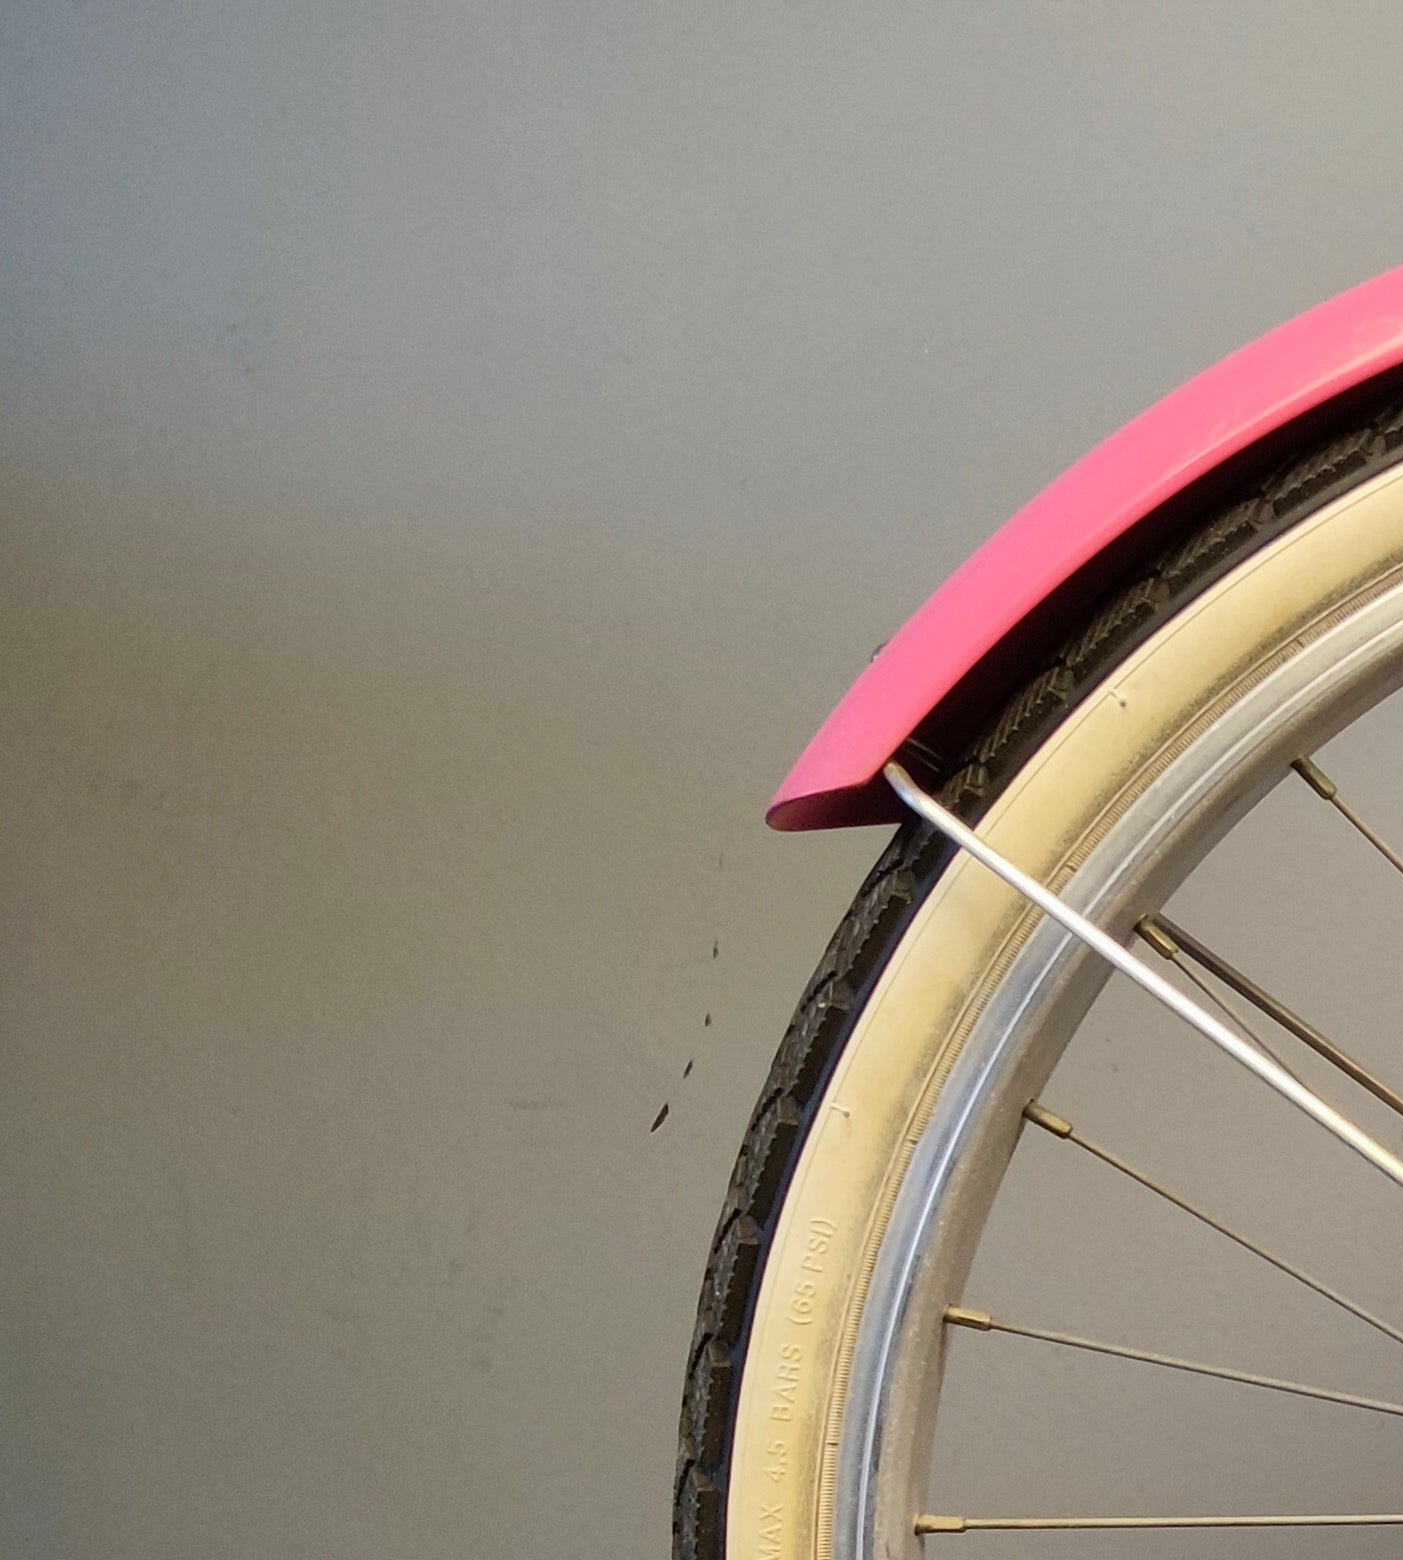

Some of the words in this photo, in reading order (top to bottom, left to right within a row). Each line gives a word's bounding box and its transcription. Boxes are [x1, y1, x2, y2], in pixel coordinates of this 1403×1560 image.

[800, 1216, 838, 1274] PSI)
[785, 1279, 818, 1327] (65
[770, 1343, 802, 1422] BARS
[763, 1440, 788, 1482] 4.5
